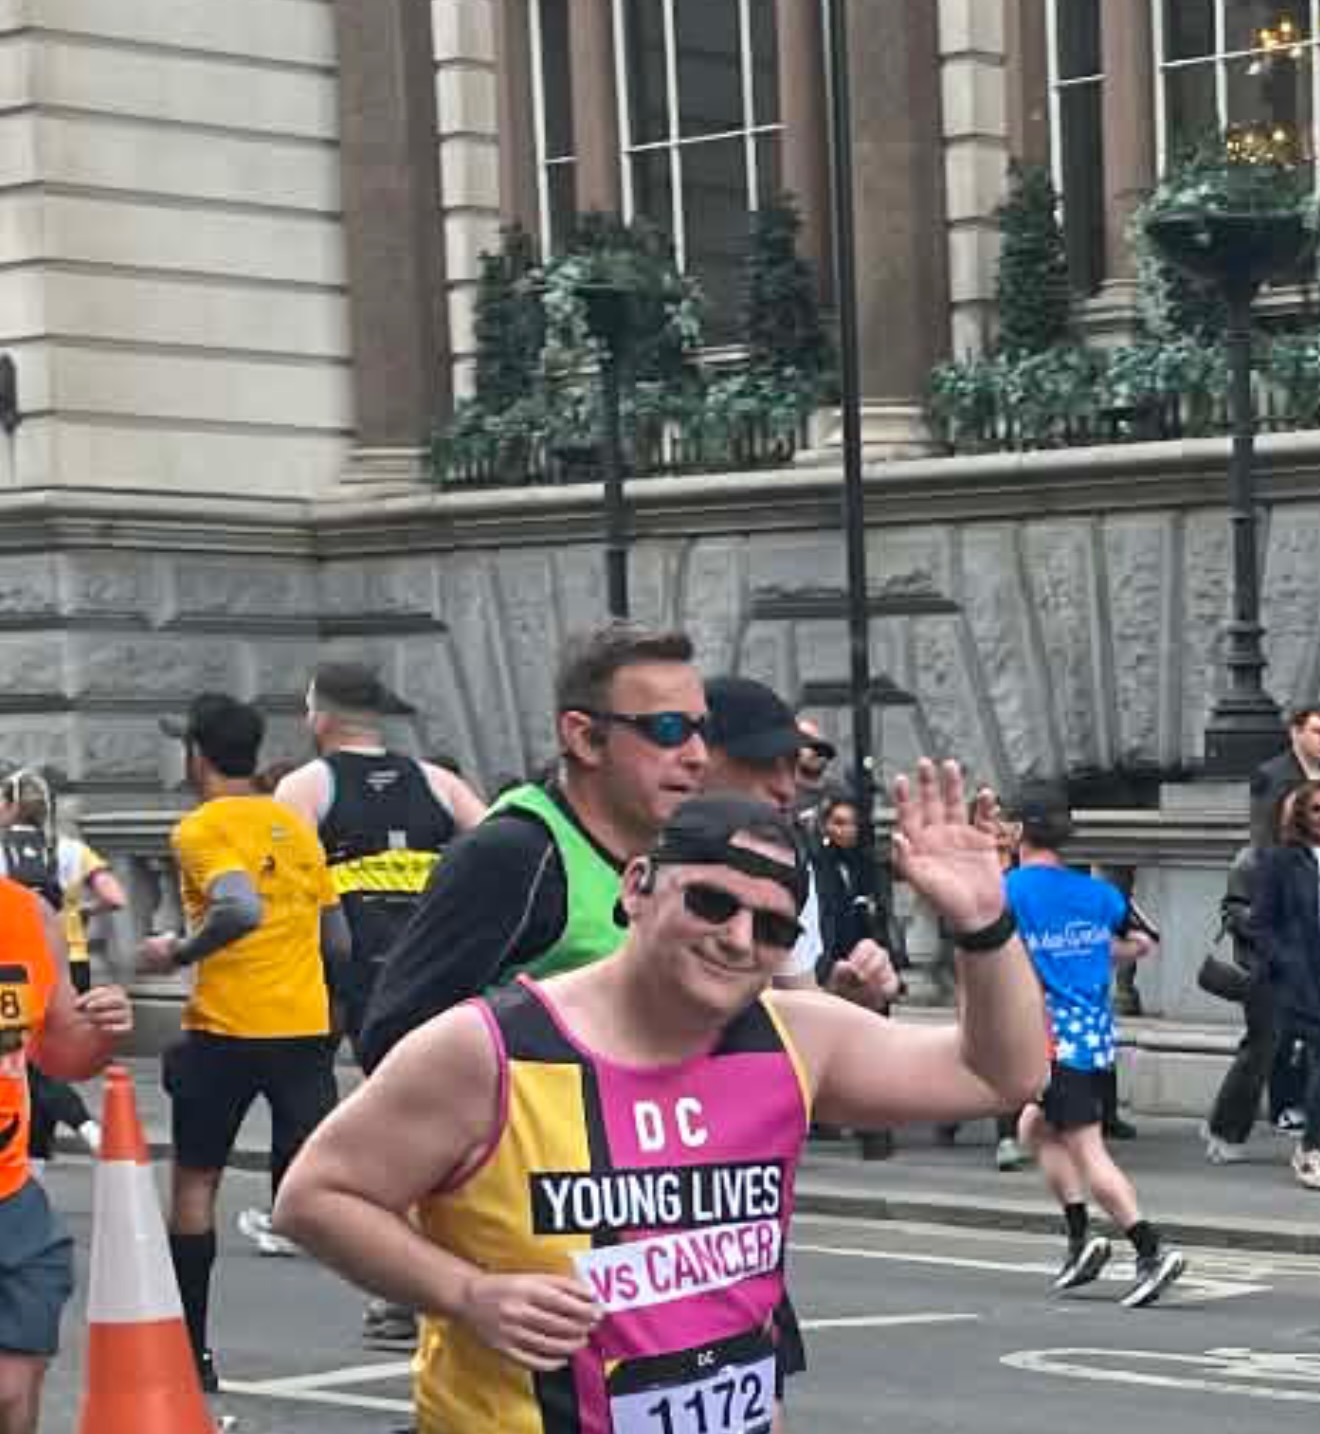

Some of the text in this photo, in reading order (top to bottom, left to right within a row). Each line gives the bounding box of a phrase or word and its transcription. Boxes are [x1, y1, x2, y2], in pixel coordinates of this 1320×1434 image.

[541, 1166, 780, 1229] YOUNG LIVES
[644, 1227, 775, 1293] CANCER
